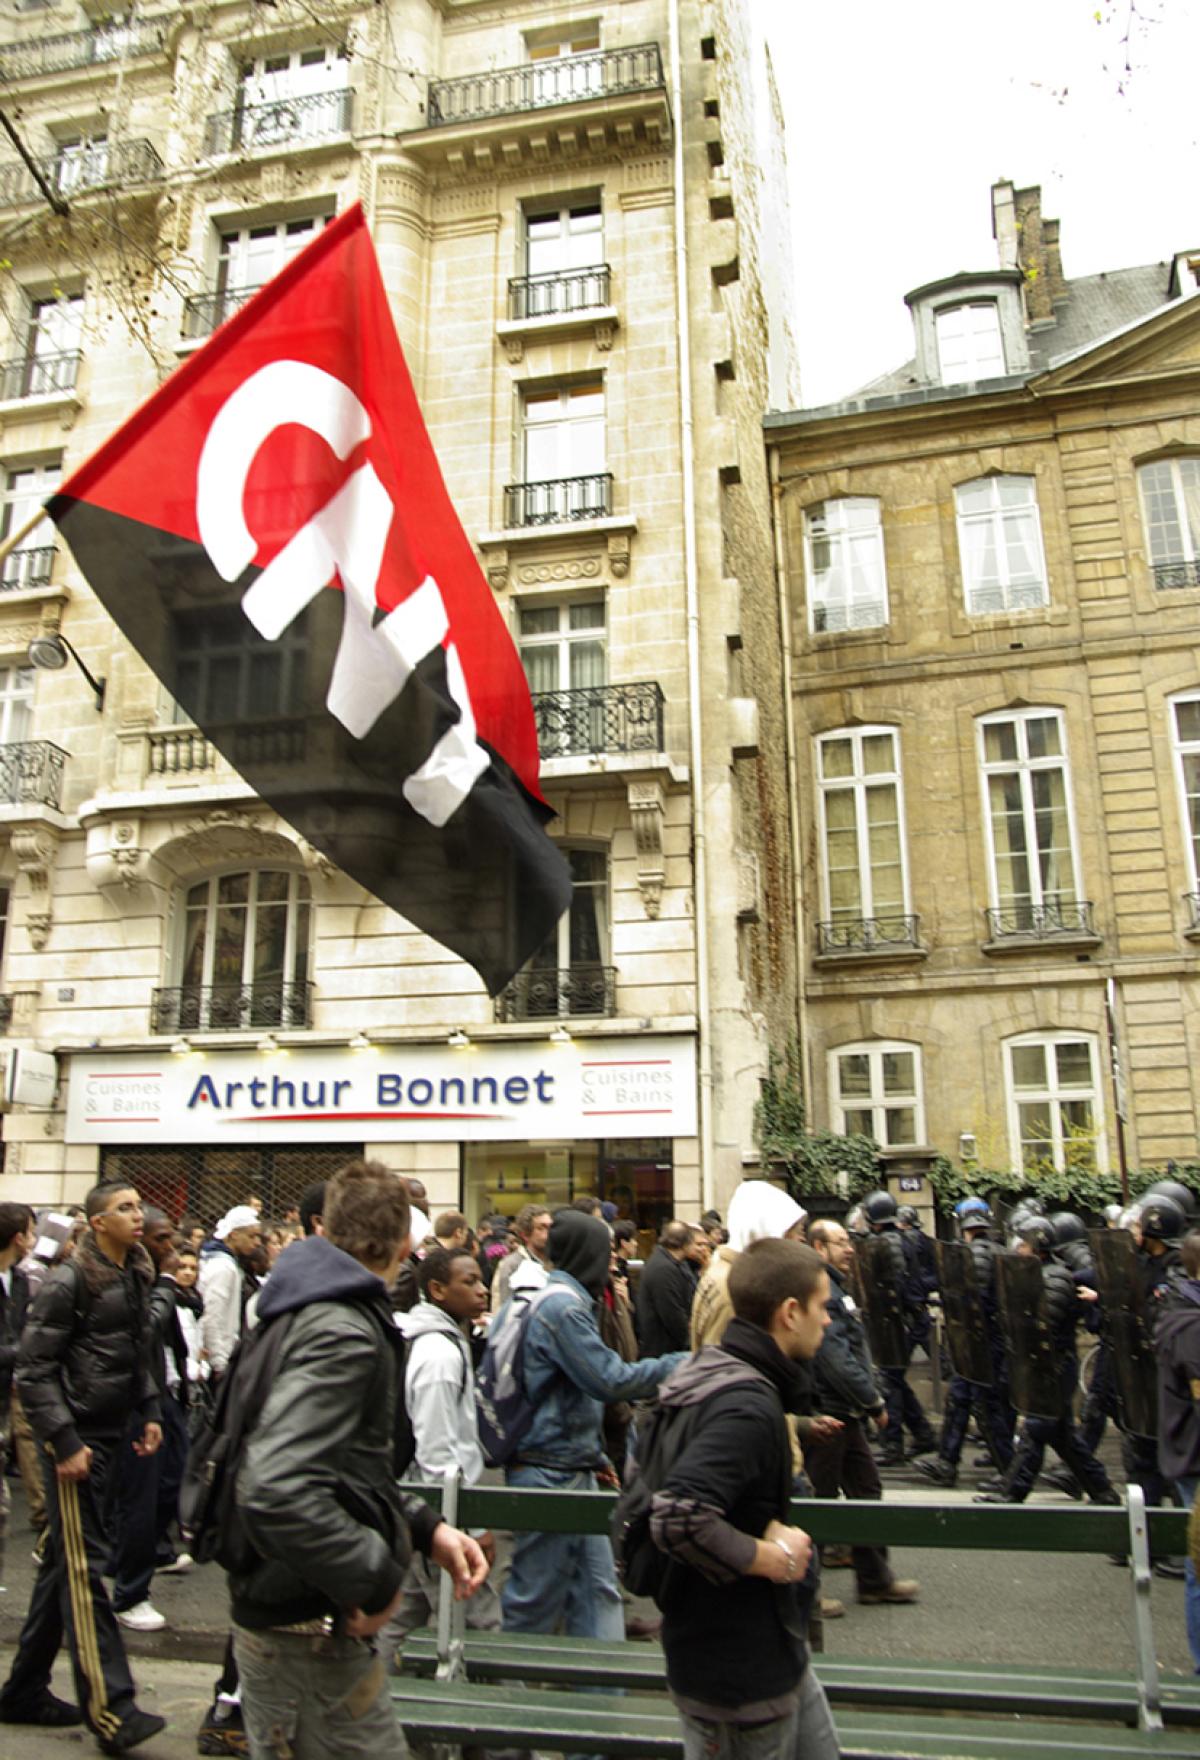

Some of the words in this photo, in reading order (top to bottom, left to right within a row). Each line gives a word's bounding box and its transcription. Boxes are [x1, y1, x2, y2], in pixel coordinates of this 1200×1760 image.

[582, 1068, 673, 1086] Cuisines
[86, 1080, 161, 1095] Cuisines
[187, 1074, 350, 1109] Arthur
[377, 1070, 554, 1106] Bonnet
[582, 1089, 595, 1104] &
[616, 1087, 673, 1103] Bains
[85, 1099, 97, 1113] &
[112, 1099, 161, 1113] Bains
